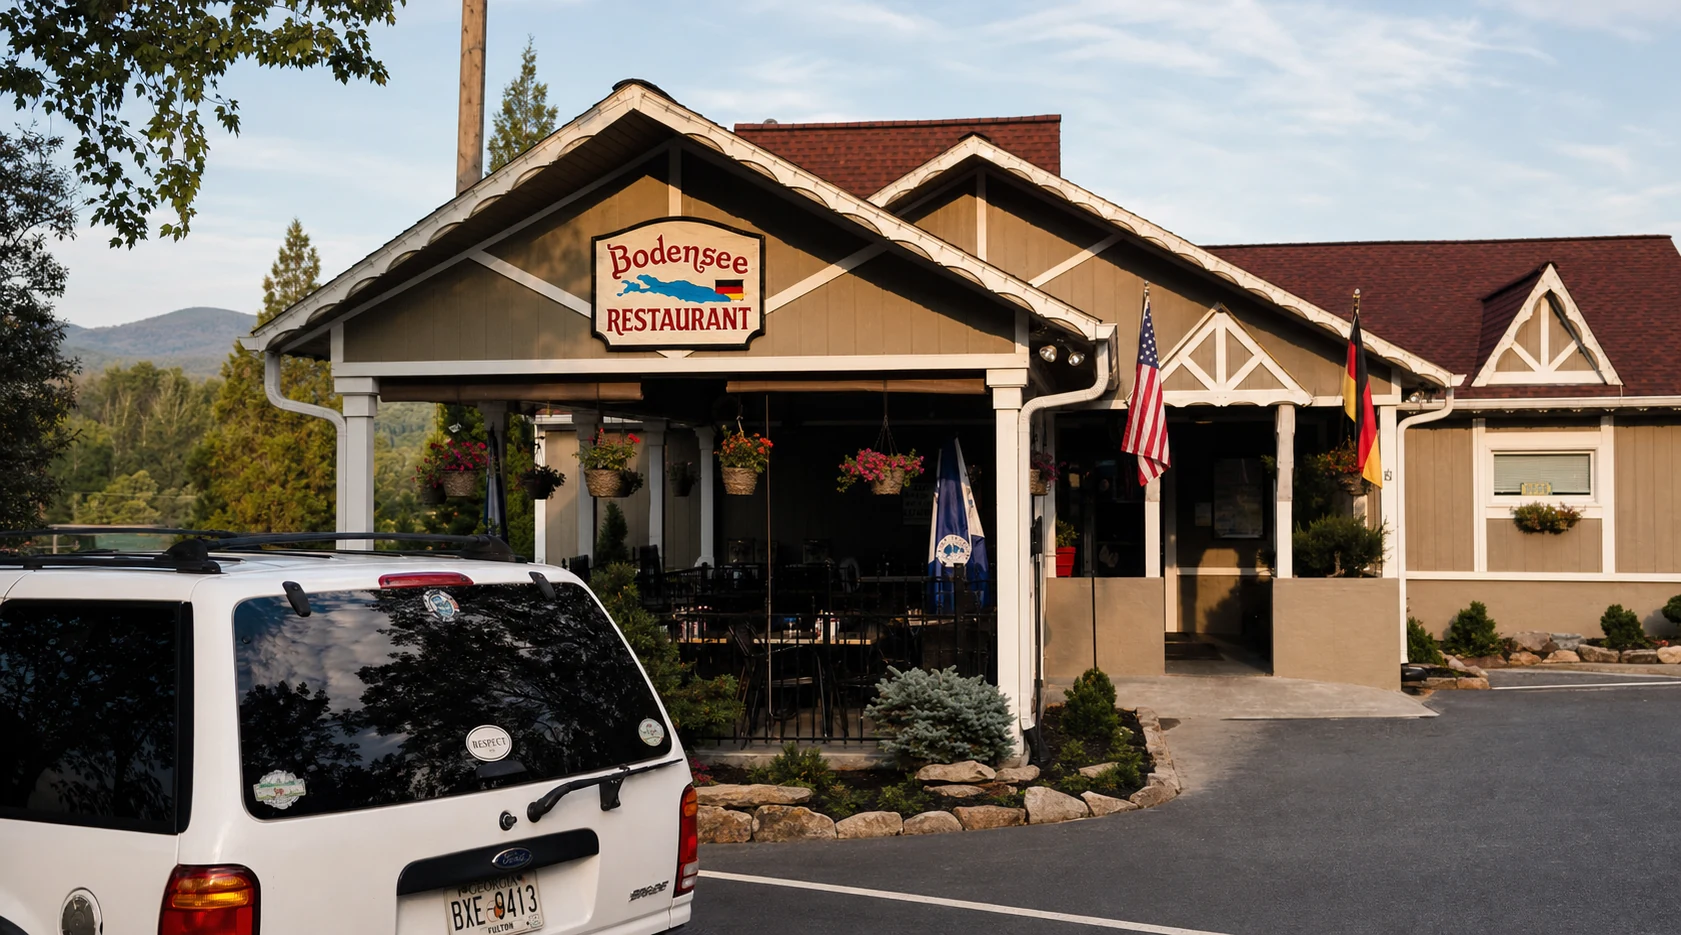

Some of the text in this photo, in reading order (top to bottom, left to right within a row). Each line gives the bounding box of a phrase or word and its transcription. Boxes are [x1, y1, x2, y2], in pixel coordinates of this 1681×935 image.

[607, 234, 748, 279] Bodensee
[606, 307, 751, 335] RESTAURANT
[472, 737, 506, 749] RESPECT
[451, 884, 537, 931] BXE 9413
[488, 922, 514, 934] FULTON
